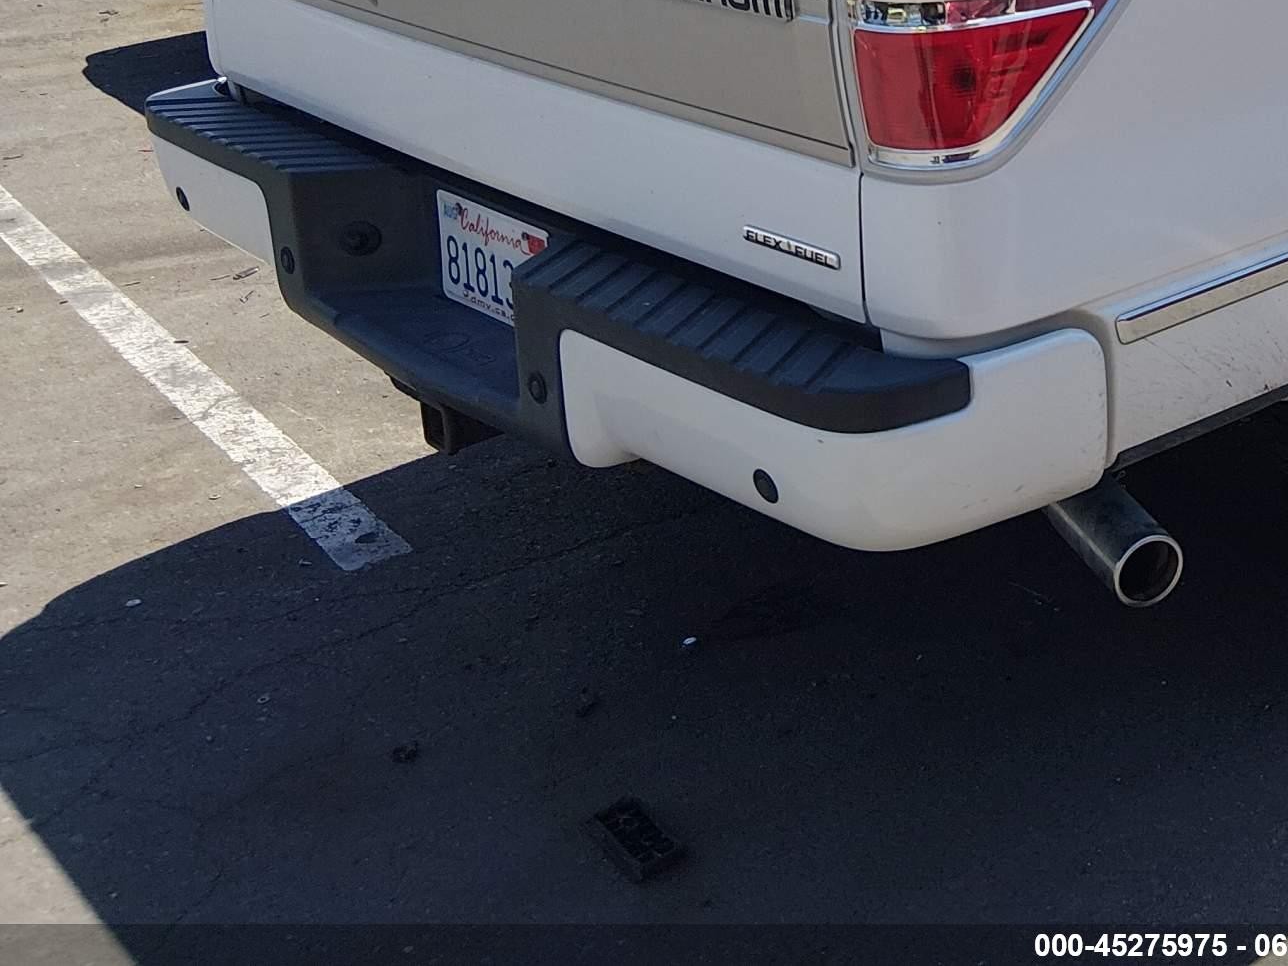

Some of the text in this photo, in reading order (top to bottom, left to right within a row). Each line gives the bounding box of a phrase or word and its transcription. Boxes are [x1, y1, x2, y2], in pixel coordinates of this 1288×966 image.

[460, 207, 521, 248] California
[746, 229, 837, 269] FLEX FUEL
